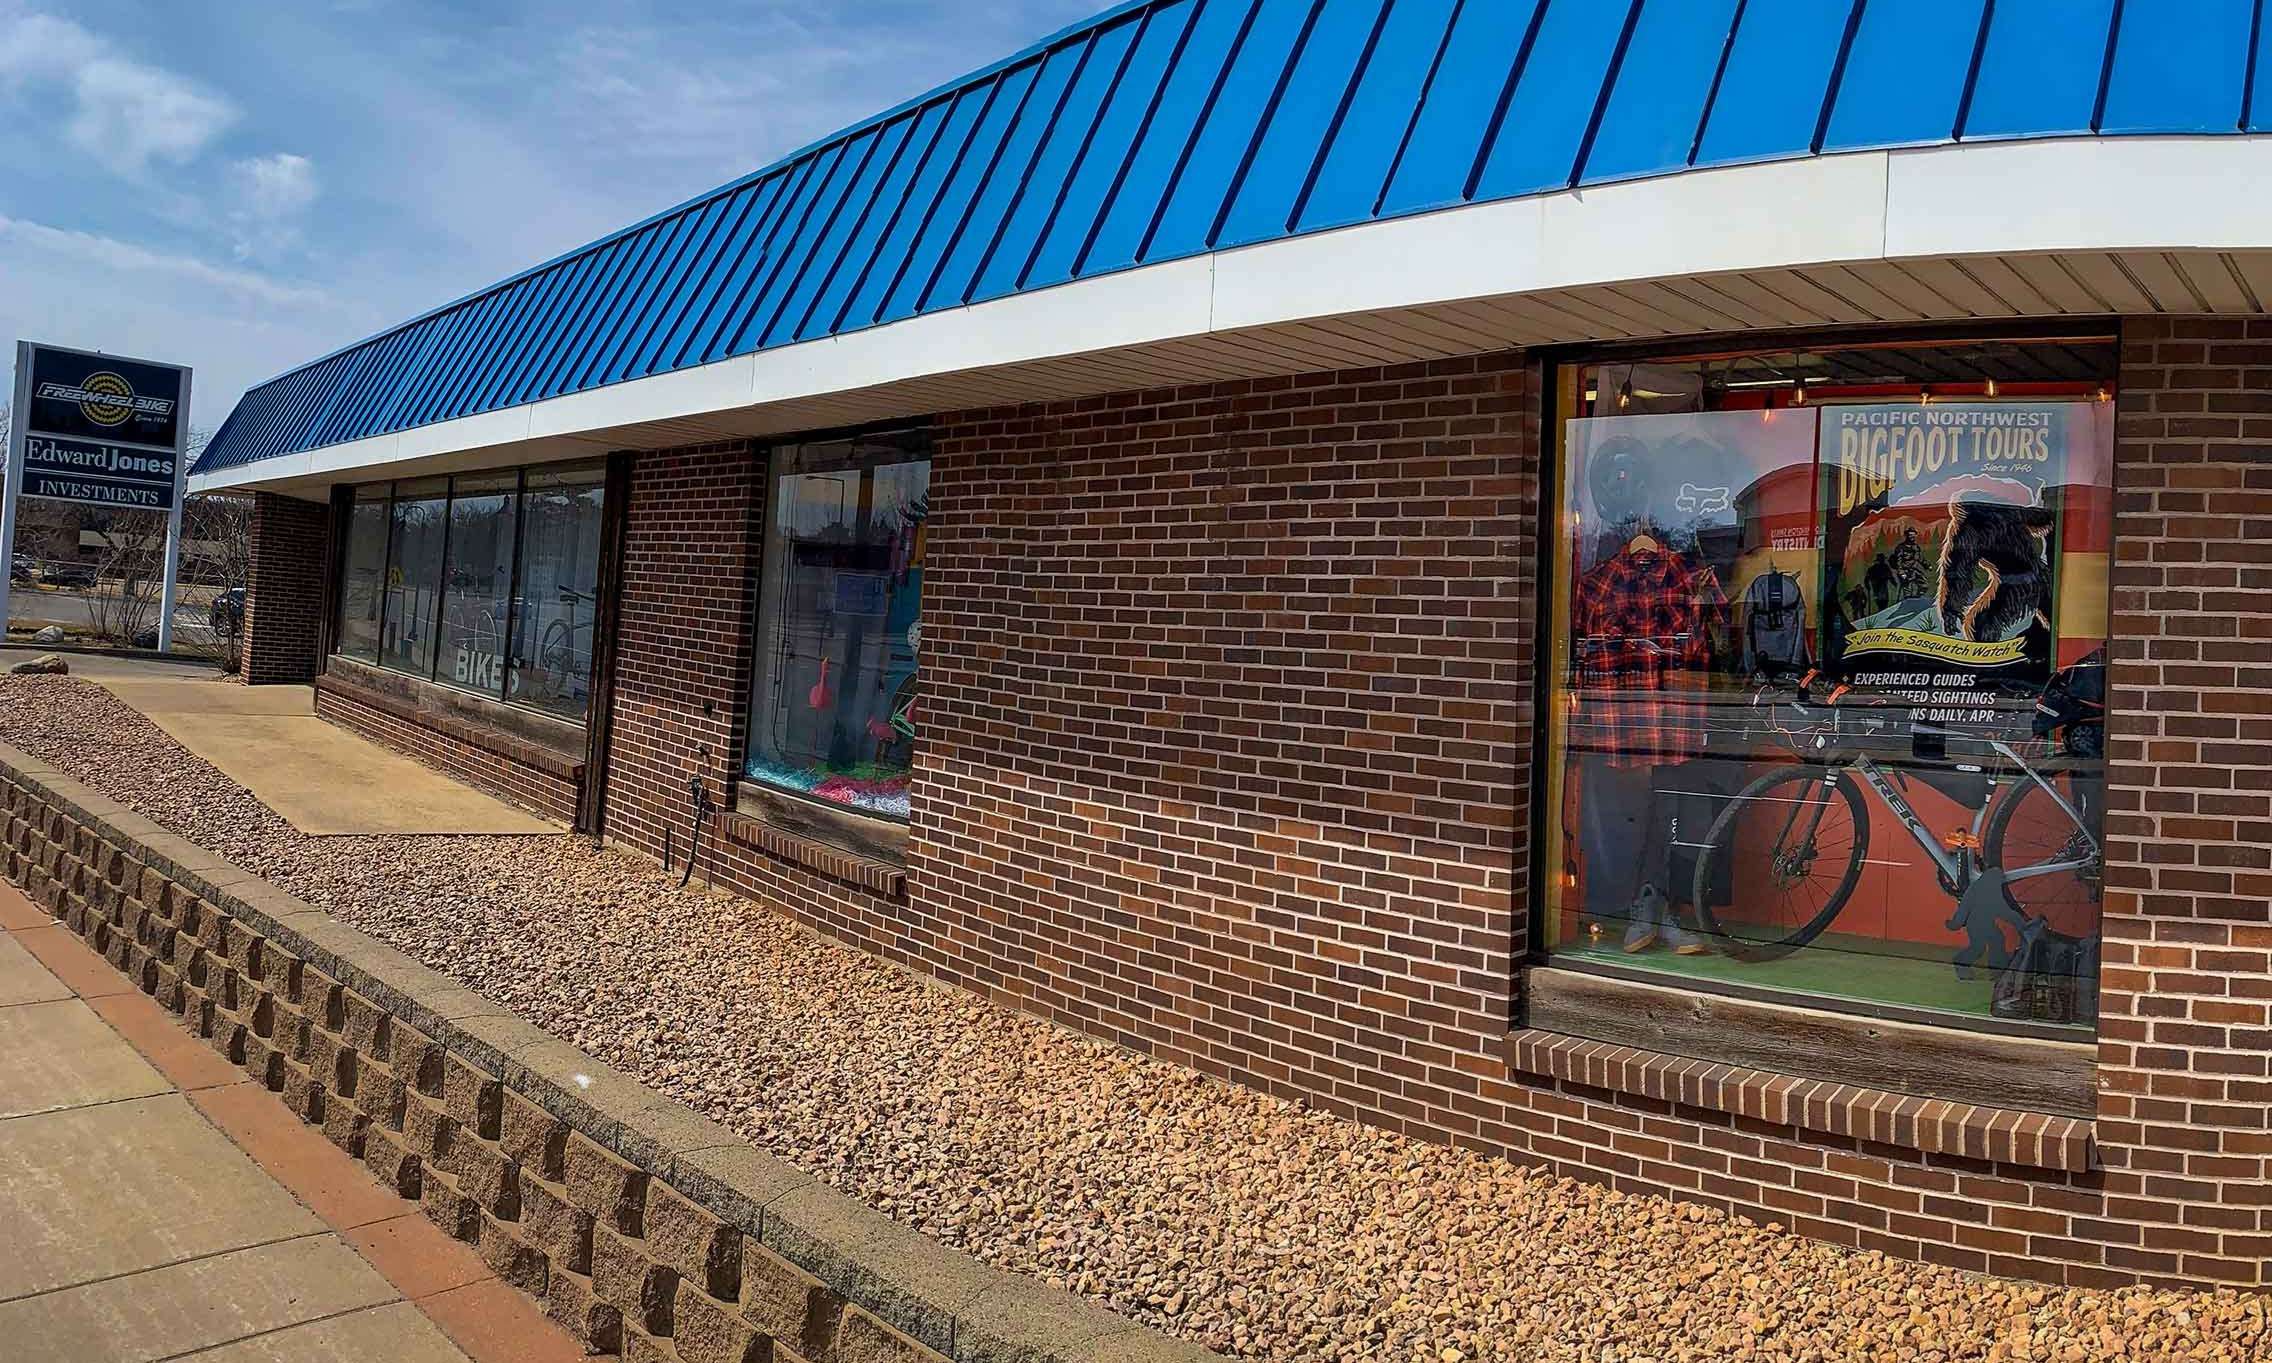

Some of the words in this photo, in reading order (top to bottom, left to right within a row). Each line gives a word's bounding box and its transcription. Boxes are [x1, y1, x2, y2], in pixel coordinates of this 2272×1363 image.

[42, 386, 134, 407] FREEWHEEL
[135, 399, 169, 412] BIKE
[1841, 412, 1919, 425] PACIFIC
[1926, 412, 2053, 426] NORTHWEST
[25, 438, 107, 467] Edward
[108, 447, 174, 474] Jones
[1981, 463, 2007, 473] Since
[2009, 463, 2032, 473] 1946
[1838, 426, 1964, 516] BIGFOOT
[1972, 427, 2049, 462] TOURS
[40, 480, 159, 504] INVESTMENTS
[1885, 632, 1904, 643] the
[1906, 635, 1969, 656] Sasquatch
[1854, 672, 1930, 686] EXPERIENCED
[1933, 674, 1976, 687] GUIDES
[1931, 691, 1997, 705] SIGHTINGS
[1969, 709, 1995, 722] APR
[1861, 761, 1922, 832] TREK
